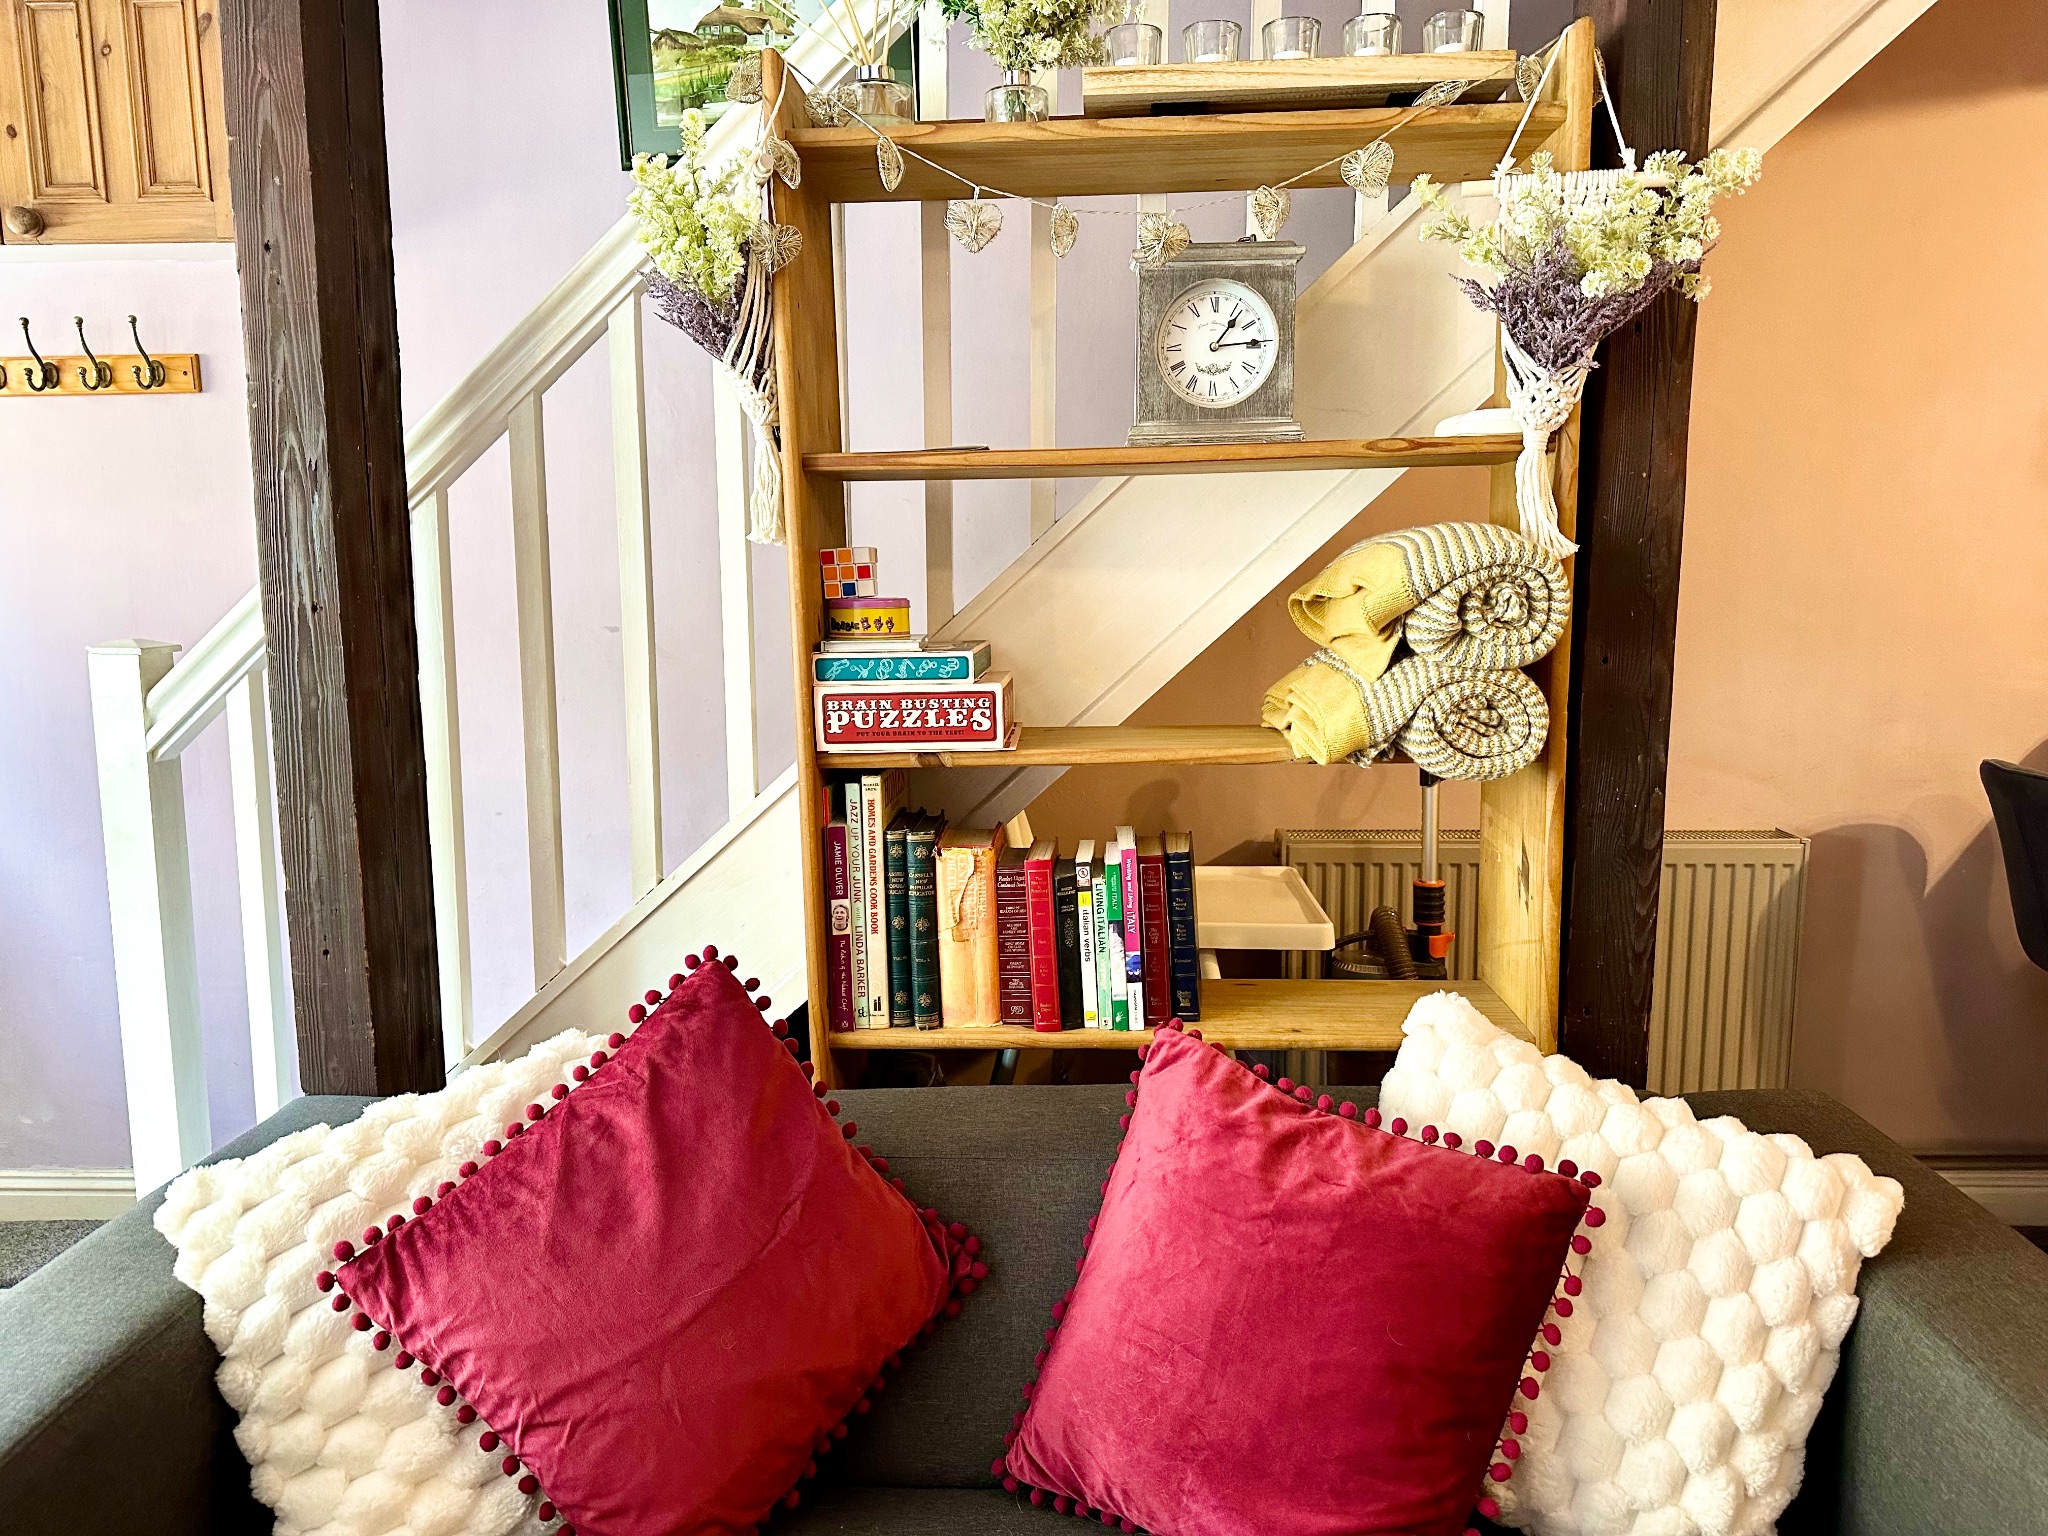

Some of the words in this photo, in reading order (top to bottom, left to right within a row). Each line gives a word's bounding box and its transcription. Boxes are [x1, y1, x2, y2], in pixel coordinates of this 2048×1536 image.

[826, 700, 892, 711] BRAIN
[900, 697, 991, 710] BUSTING
[826, 708, 992, 734] PUZZLES
[850, 798, 858, 824] JAZZ
[868, 799, 876, 828] HOMES
[850, 828, 860, 840] UP
[868, 829, 876, 847] AND
[834, 840, 842, 865] JAMIE
[851, 844, 860, 872] YOUR
[868, 848, 878, 886] GARDENS
[834, 868, 844, 896] OLIVER
[853, 876, 862, 903] JUNK
[870, 888, 878, 908] COOK
[1096, 884, 1104, 915] LIVING
[870, 909, 878, 934] BOOK
[1082, 910, 1091, 936] italian
[1098, 916, 1106, 953] ITALIAN
[1127, 912, 1136, 934] ITALY
[855, 926, 864, 956] LINDA
[856, 959, 866, 998] BARKER
